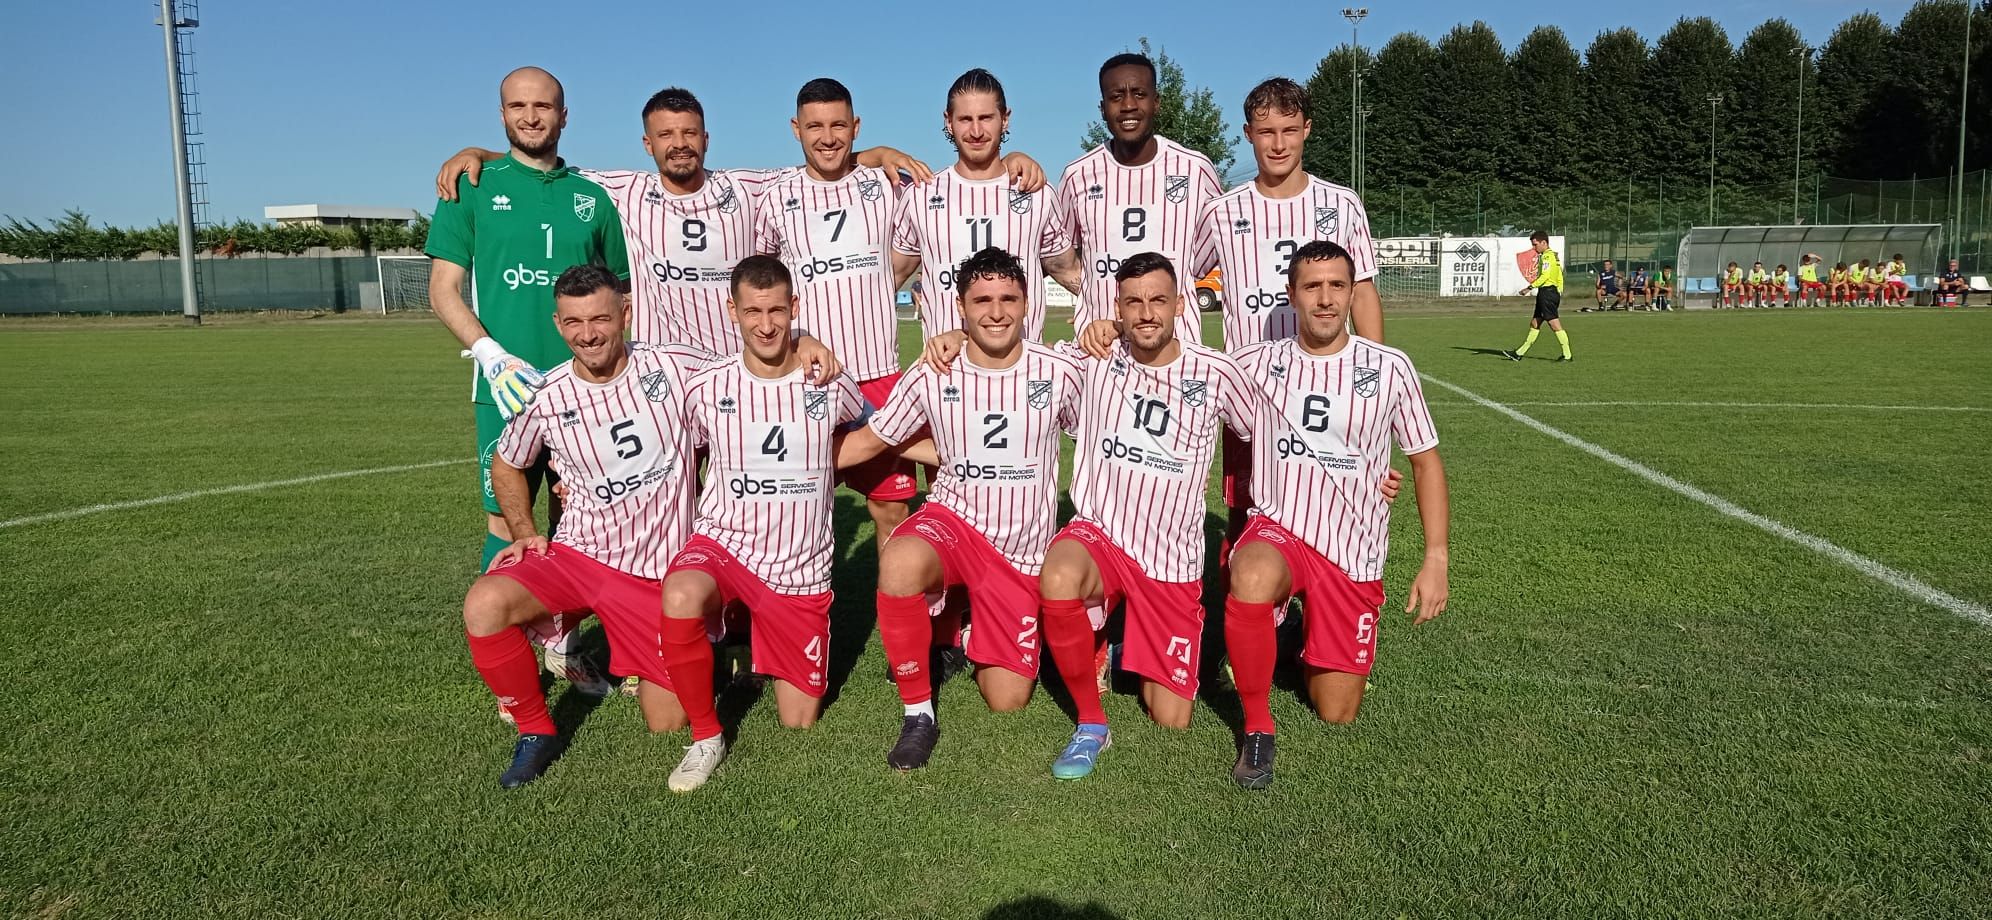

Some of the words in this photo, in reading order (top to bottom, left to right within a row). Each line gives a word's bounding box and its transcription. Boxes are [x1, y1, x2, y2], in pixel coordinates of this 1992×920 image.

[682, 219, 707, 252] 9
[823, 209, 847, 243] 7
[965, 218, 992, 252] 11
[1122, 208, 1146, 242] 8
[541, 223, 553, 259] 1
[1372, 240, 1430, 257] ODI
[800, 256, 844, 283] gbs
[855, 261, 879, 269] MOTION
[1096, 254, 1126, 278] gb
[1274, 240, 1298, 275] 3
[1376, 257, 1430, 265] ENSILERIA
[503, 263, 550, 290] gbs
[653, 260, 699, 283] gbs
[939, 265, 961, 290] gb
[1245, 288, 1290, 314] gbs
[1133, 393, 1170, 437] 10
[1302, 394, 1331, 433] 6
[610, 419, 643, 460] 5
[762, 425, 788, 462] 4
[983, 414, 1008, 449] 2
[1102, 435, 1143, 464] gbs
[1146, 455, 1184, 468] SERVICES
[1319, 456, 1356, 465] SERVICES
[954, 459, 997, 482] gbs
[1154, 463, 1184, 474] MOTION
[1327, 462, 1357, 471] MOTION
[595, 477, 641, 504] gbs
[730, 473, 778, 499] gbs
[1017, 615, 1038, 650] 2
[804, 635, 822, 668] 4
